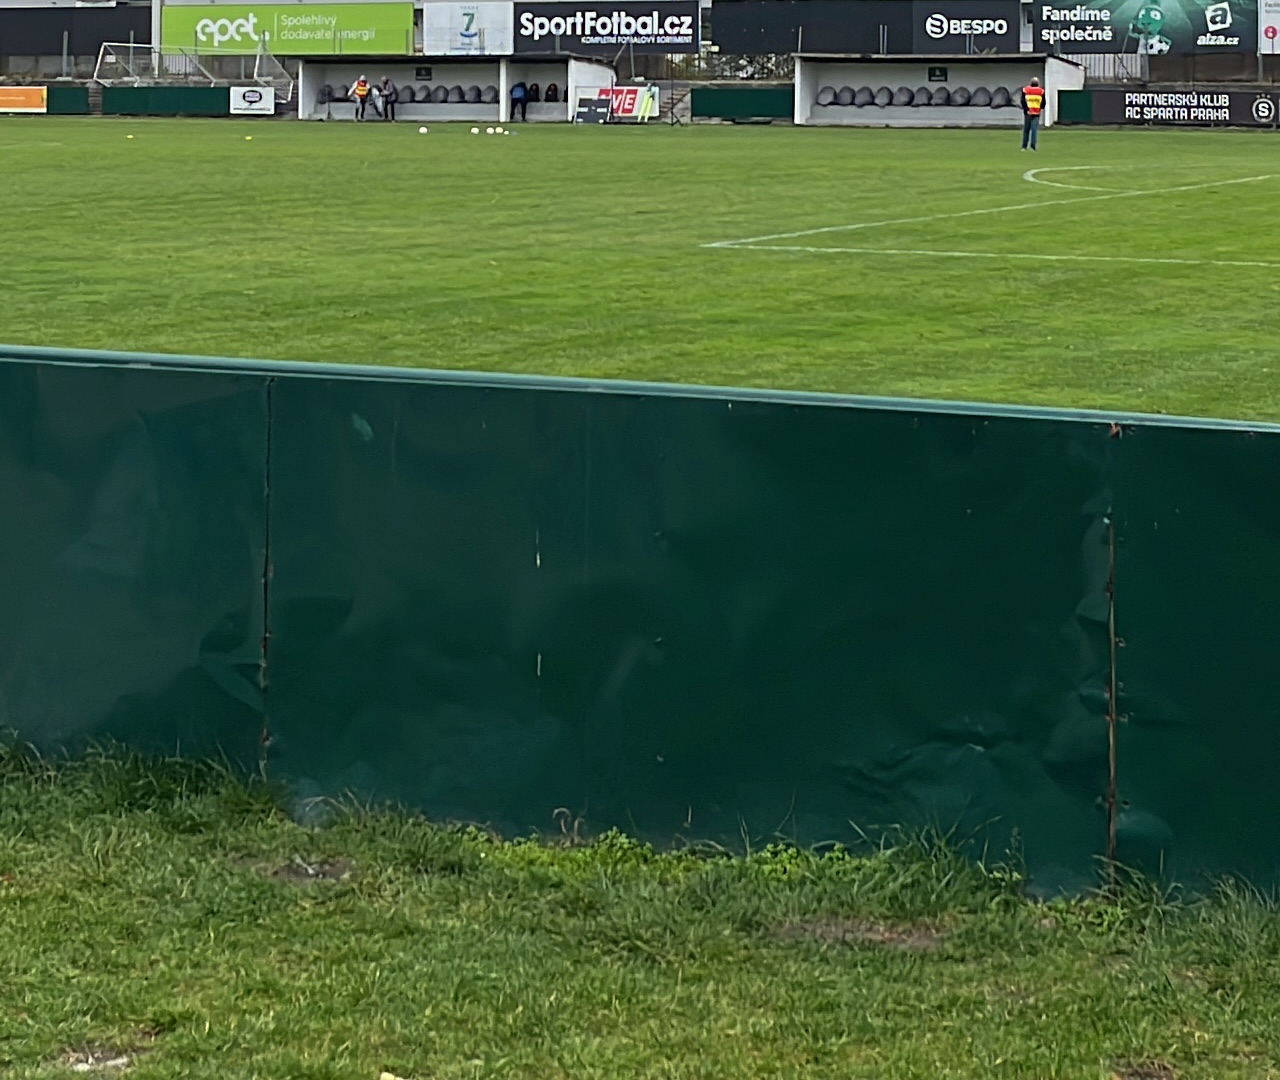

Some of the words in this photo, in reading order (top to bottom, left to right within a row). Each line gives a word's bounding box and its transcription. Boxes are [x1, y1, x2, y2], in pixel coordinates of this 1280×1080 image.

[280, 14, 337, 27] Spolehlivý
[1041, 5, 1111, 21] Fandíme
[462, 12, 475, 32] 7
[520, 11, 693, 40] SportFotbal.cz
[949, 19, 1008, 34] BESPO
[280, 28, 334, 40] dodavatel
[1041, 24, 1113, 44] společně
[1196, 33, 1239, 45] alza.cz
[1125, 91, 1198, 106] PARTNERSKÝ
[1199, 94, 1230, 107] KLUB
[1125, 107, 1141, 119] AC
[1143, 107, 1188, 120] SPARTA
[1190, 108, 1230, 120] PRAHA
